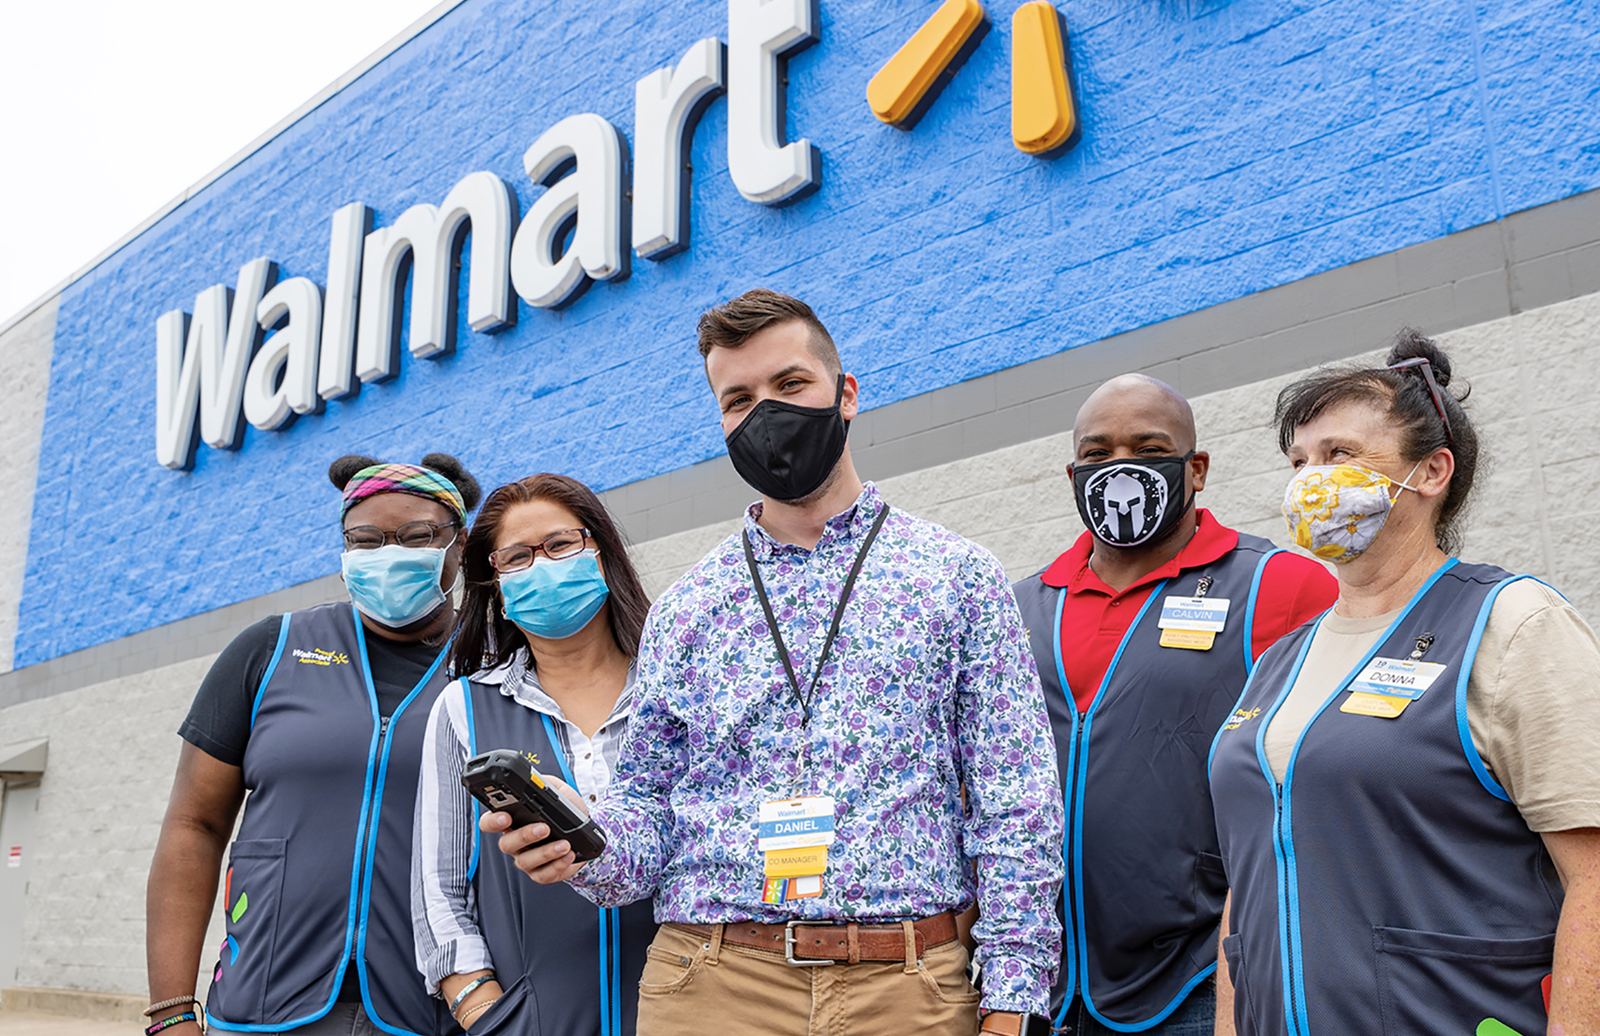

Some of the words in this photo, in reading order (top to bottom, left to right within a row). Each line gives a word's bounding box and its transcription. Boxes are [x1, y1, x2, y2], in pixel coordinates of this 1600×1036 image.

[155, 0, 820, 471] Walmart
[1172, 609, 1213, 620] CALVIN
[292, 649, 333, 662] Walmart
[1388, 664, 1417, 673] Walmart
[1369, 671, 1416, 686] DONNA
[777, 808, 806, 818] Walmart
[775, 820, 819, 834] DANIEL
[768, 858, 780, 866] CO
[781, 855, 818, 865] MANAGER
